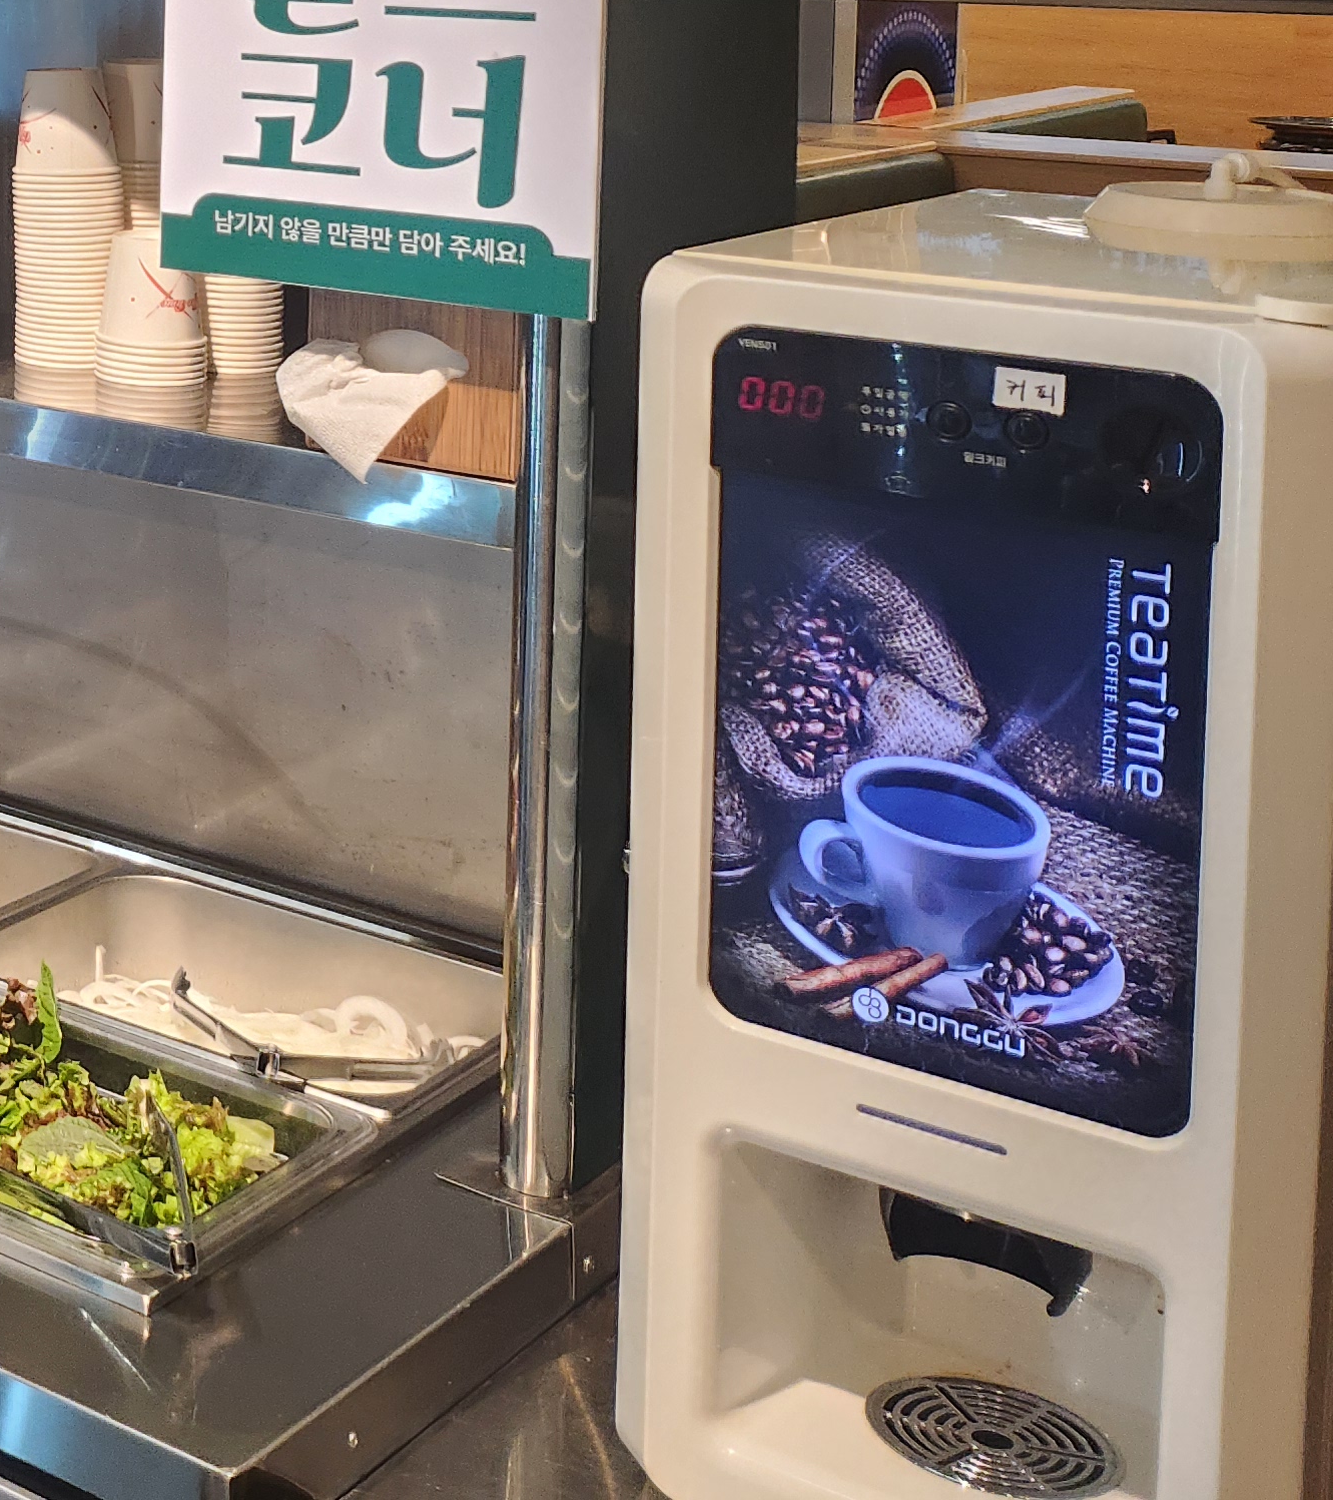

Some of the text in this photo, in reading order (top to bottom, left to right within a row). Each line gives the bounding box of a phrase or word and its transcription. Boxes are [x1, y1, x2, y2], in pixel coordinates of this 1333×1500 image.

[223, 53, 526, 208] 코너
[214, 210, 526, 266] 남기지 않을 만큼만 담아 주세요!
[738, 377, 825, 420] 000
[963, 451, 1007, 468] 밀크커피
[1101, 558, 1125, 788] PREMIUM COFFEE MACHINE
[895, 1005, 1025, 1057] DONGGU
